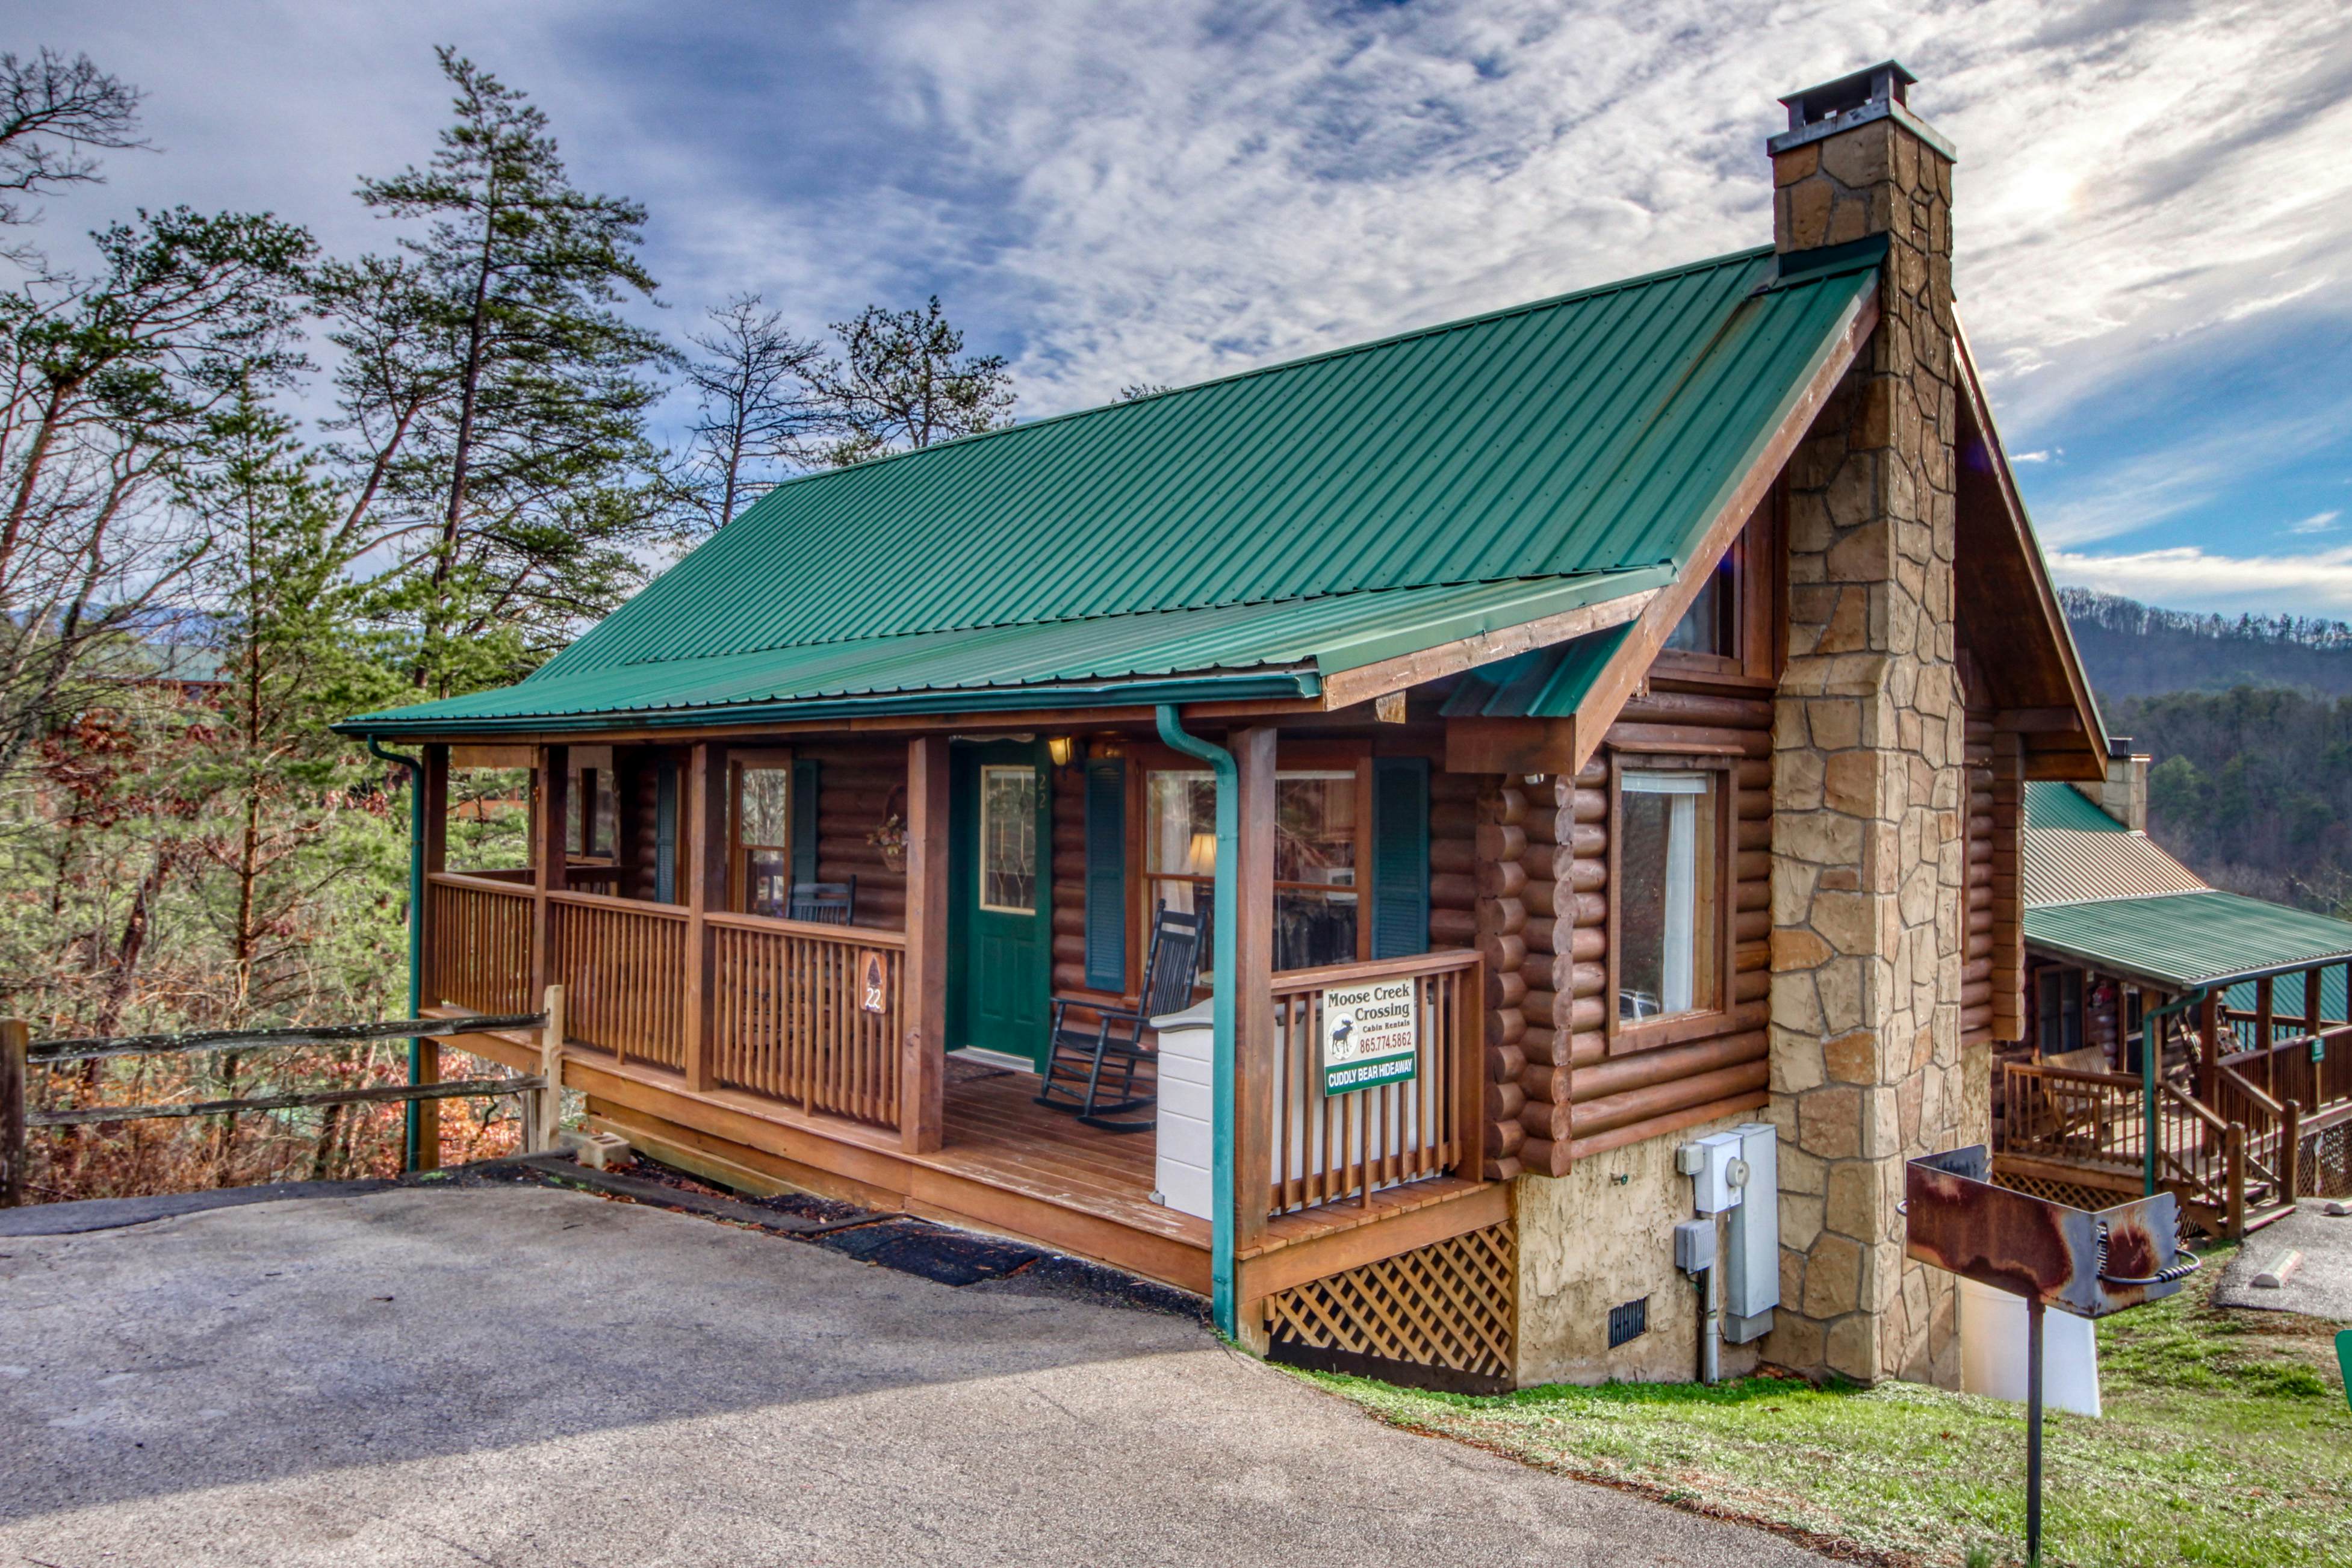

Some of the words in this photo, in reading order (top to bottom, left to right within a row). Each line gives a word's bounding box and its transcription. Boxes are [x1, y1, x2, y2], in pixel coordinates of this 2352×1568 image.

[865, 988, 880, 1009] 22
[1329, 991, 1370, 1008] Moose
[1374, 984, 1410, 1000] Creek
[1355, 1003, 1410, 1021] Crossing
[1362, 1023, 1382, 1033] Cabin
[1385, 1020, 1410, 1029] Rentals
[1360, 1031, 1411, 1054] 865.774.5862
[1329, 1069, 1357, 1087] CUDDLY
[1358, 1065, 1378, 1082] BEAR
[1379, 1058, 1412, 1077] HIDEAWAY
